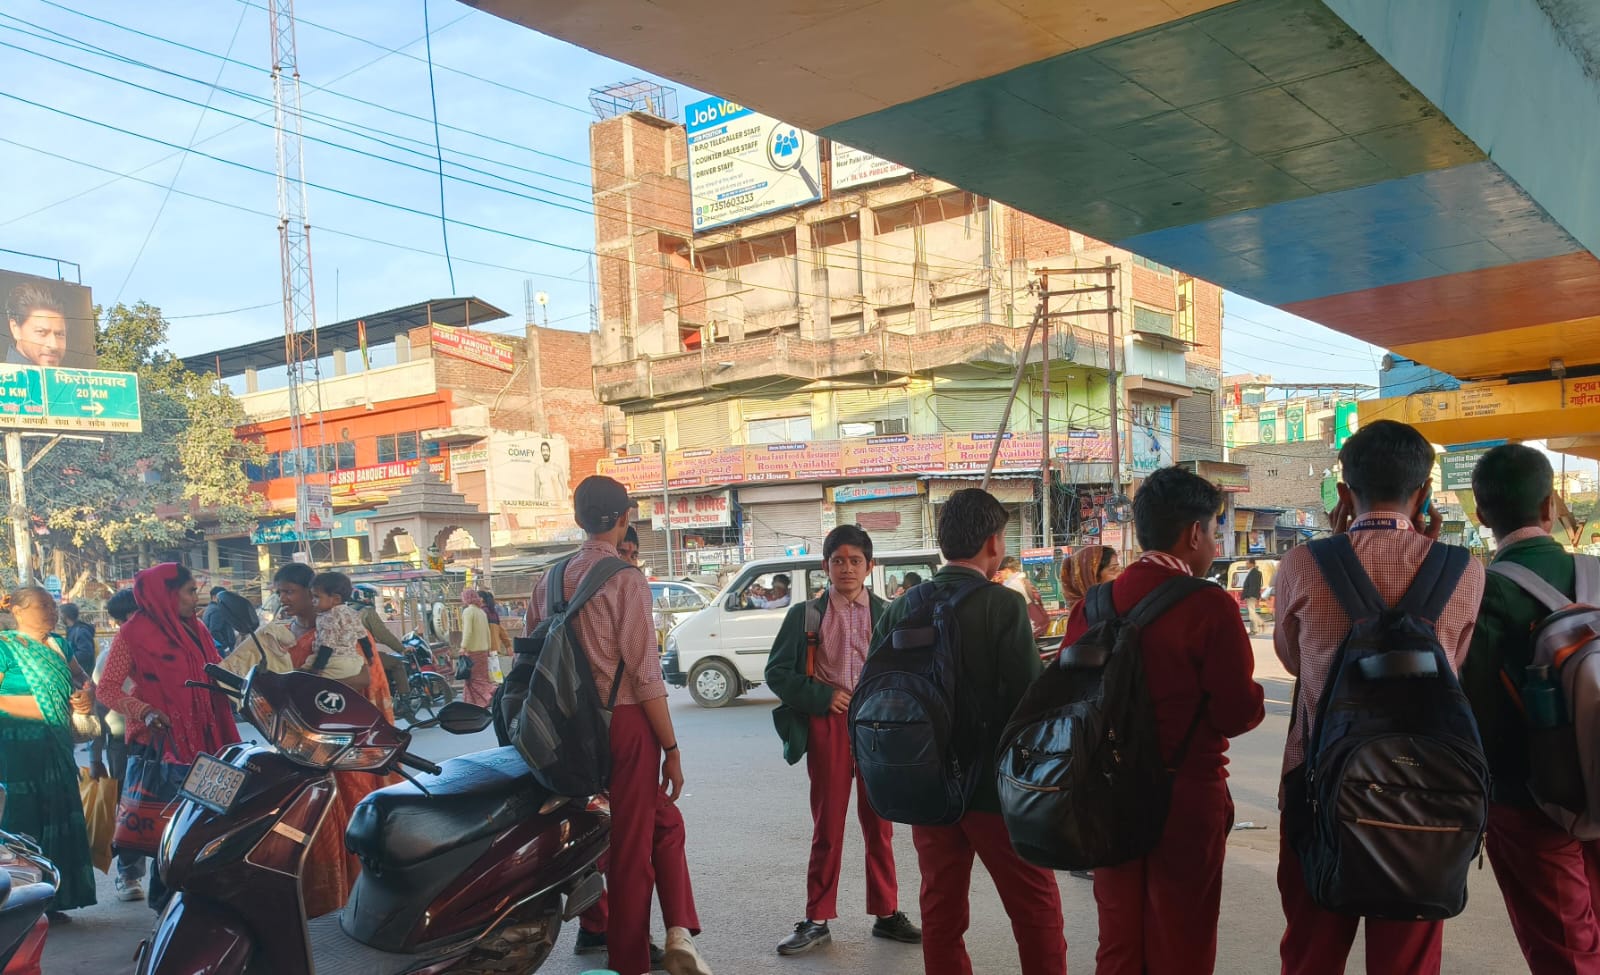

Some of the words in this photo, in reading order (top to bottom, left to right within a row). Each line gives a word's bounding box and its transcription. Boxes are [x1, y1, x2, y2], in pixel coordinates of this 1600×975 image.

[691, 106, 718, 127] Job
[710, 131, 743, 148] TELECALLER
[743, 125, 760, 137] STAFF
[695, 151, 722, 165] COUNTER
[722, 146, 740, 157] SALES
[740, 140, 758, 152] STAFF
[696, 166, 717, 178] DRIVER
[717, 161, 734, 172] STAFF
[869, 166, 889, 176] PUBLIC
[710, 192, 754, 212] 7351603233
[494, 347, 512, 359] HALL
[9, 387, 27, 398] KM
[76, 388, 89, 398] 20
[91, 389, 108, 399] KM
[508, 447, 535, 457] COMFY
[806, 450, 840, 459] Restaurant
[998, 449, 1041, 458] Available
[758, 462, 789, 471] Rooms
[791, 459, 836, 470] Available
[356, 465, 387, 482] BANQUET
[388, 463, 406, 478] HALL
[766, 472, 789, 480] Hours
[518, 500, 549, 508] READYMADE
